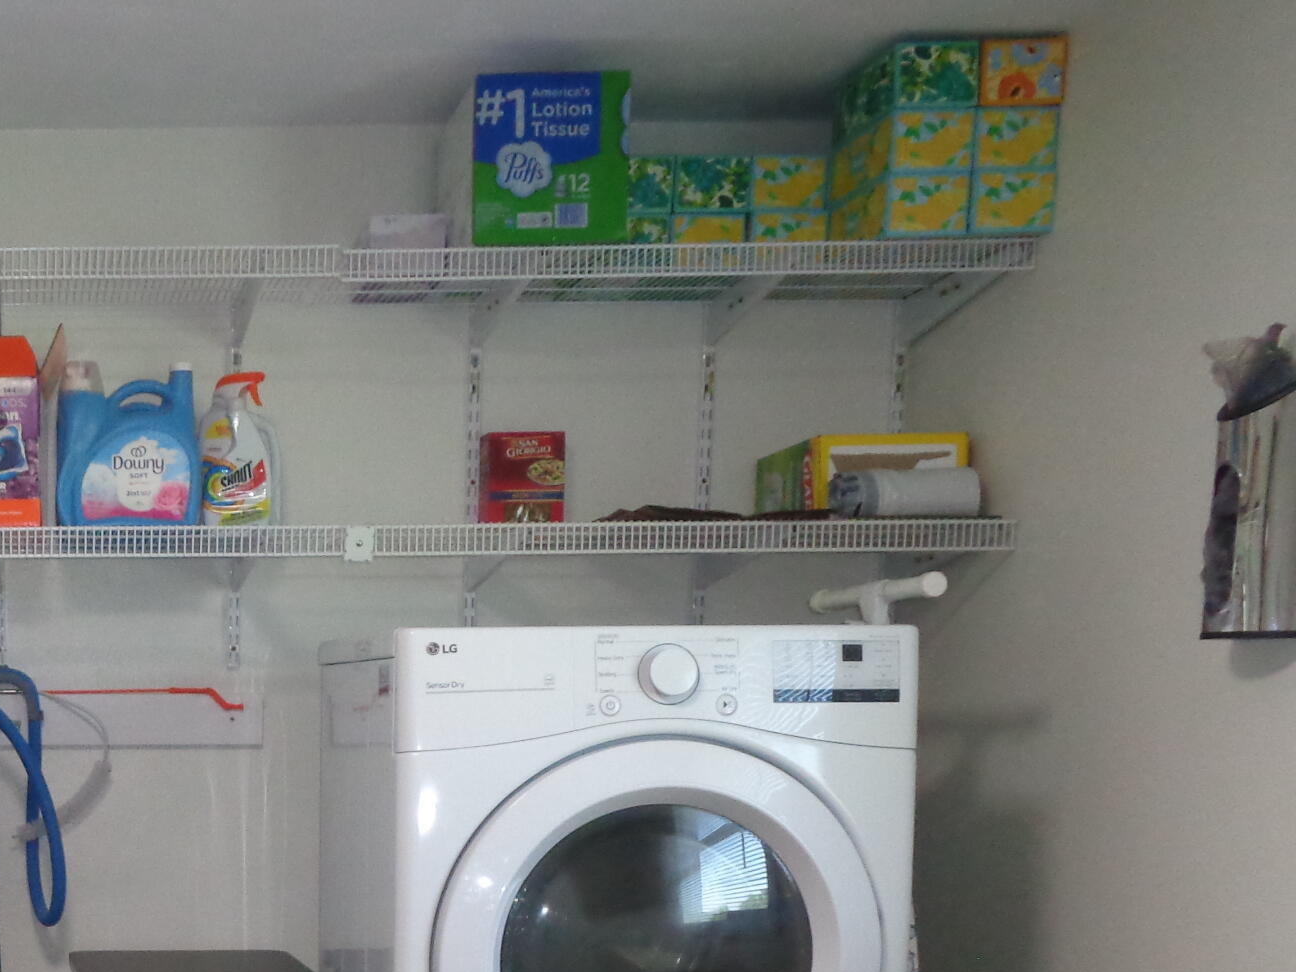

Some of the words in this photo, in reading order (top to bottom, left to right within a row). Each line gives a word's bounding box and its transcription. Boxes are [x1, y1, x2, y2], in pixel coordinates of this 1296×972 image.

[531, 87, 591, 97] America's
[475, 88, 526, 138] #1
[531, 102, 593, 117] Lotion
[531, 121, 591, 137] Tissue
[504, 152, 545, 184] Puffs
[568, 173, 591, 193] 12
[518, 439, 539, 447] SAN
[113, 455, 165, 475] Downy
[442, 644, 458, 654] LG
